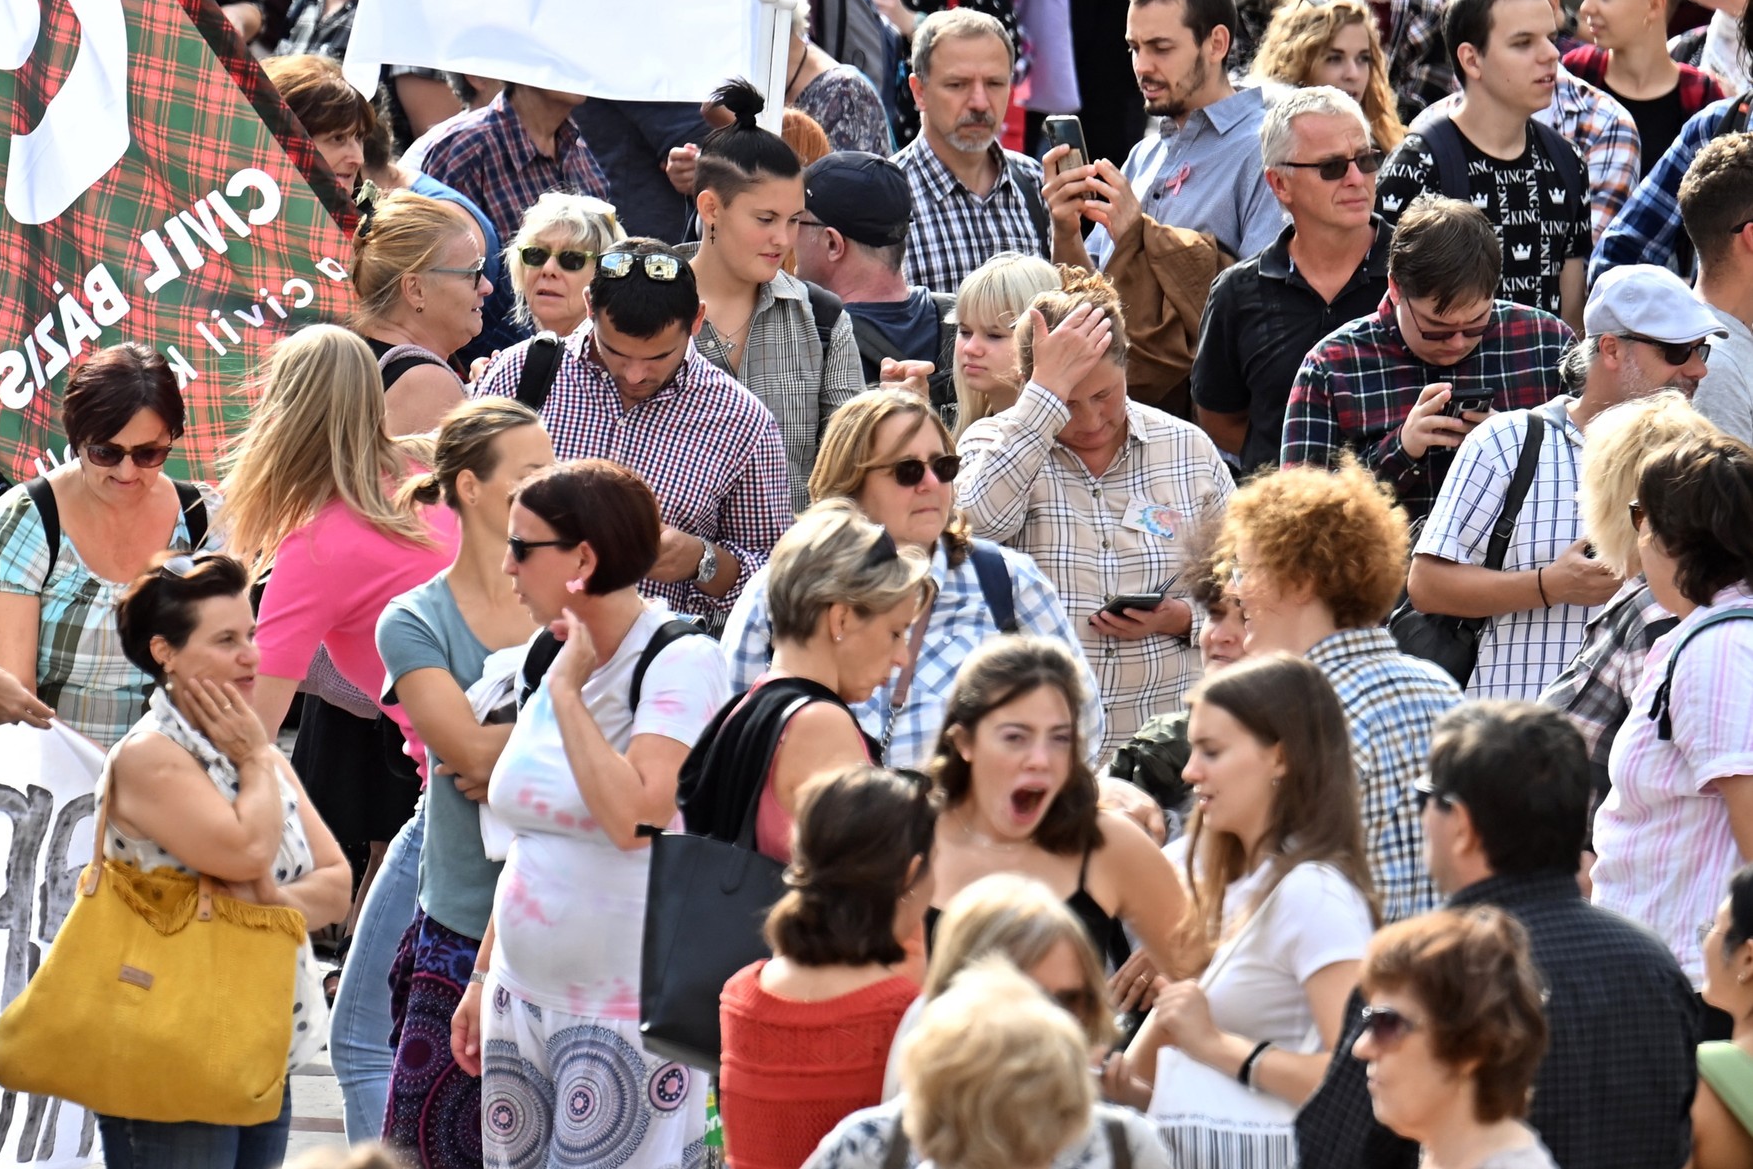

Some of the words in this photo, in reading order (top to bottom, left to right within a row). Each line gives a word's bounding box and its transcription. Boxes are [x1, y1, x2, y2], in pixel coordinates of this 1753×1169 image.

[1468, 158, 1494, 177] ING
[1542, 159, 1555, 173] KI
[1494, 168, 1525, 185] KING
[1525, 169, 1540, 209] KING
[1496, 185, 1511, 226] KING
[1510, 208, 1541, 226] KING
[1540, 236, 1551, 277] KING
[1502, 275, 1535, 293] KING
